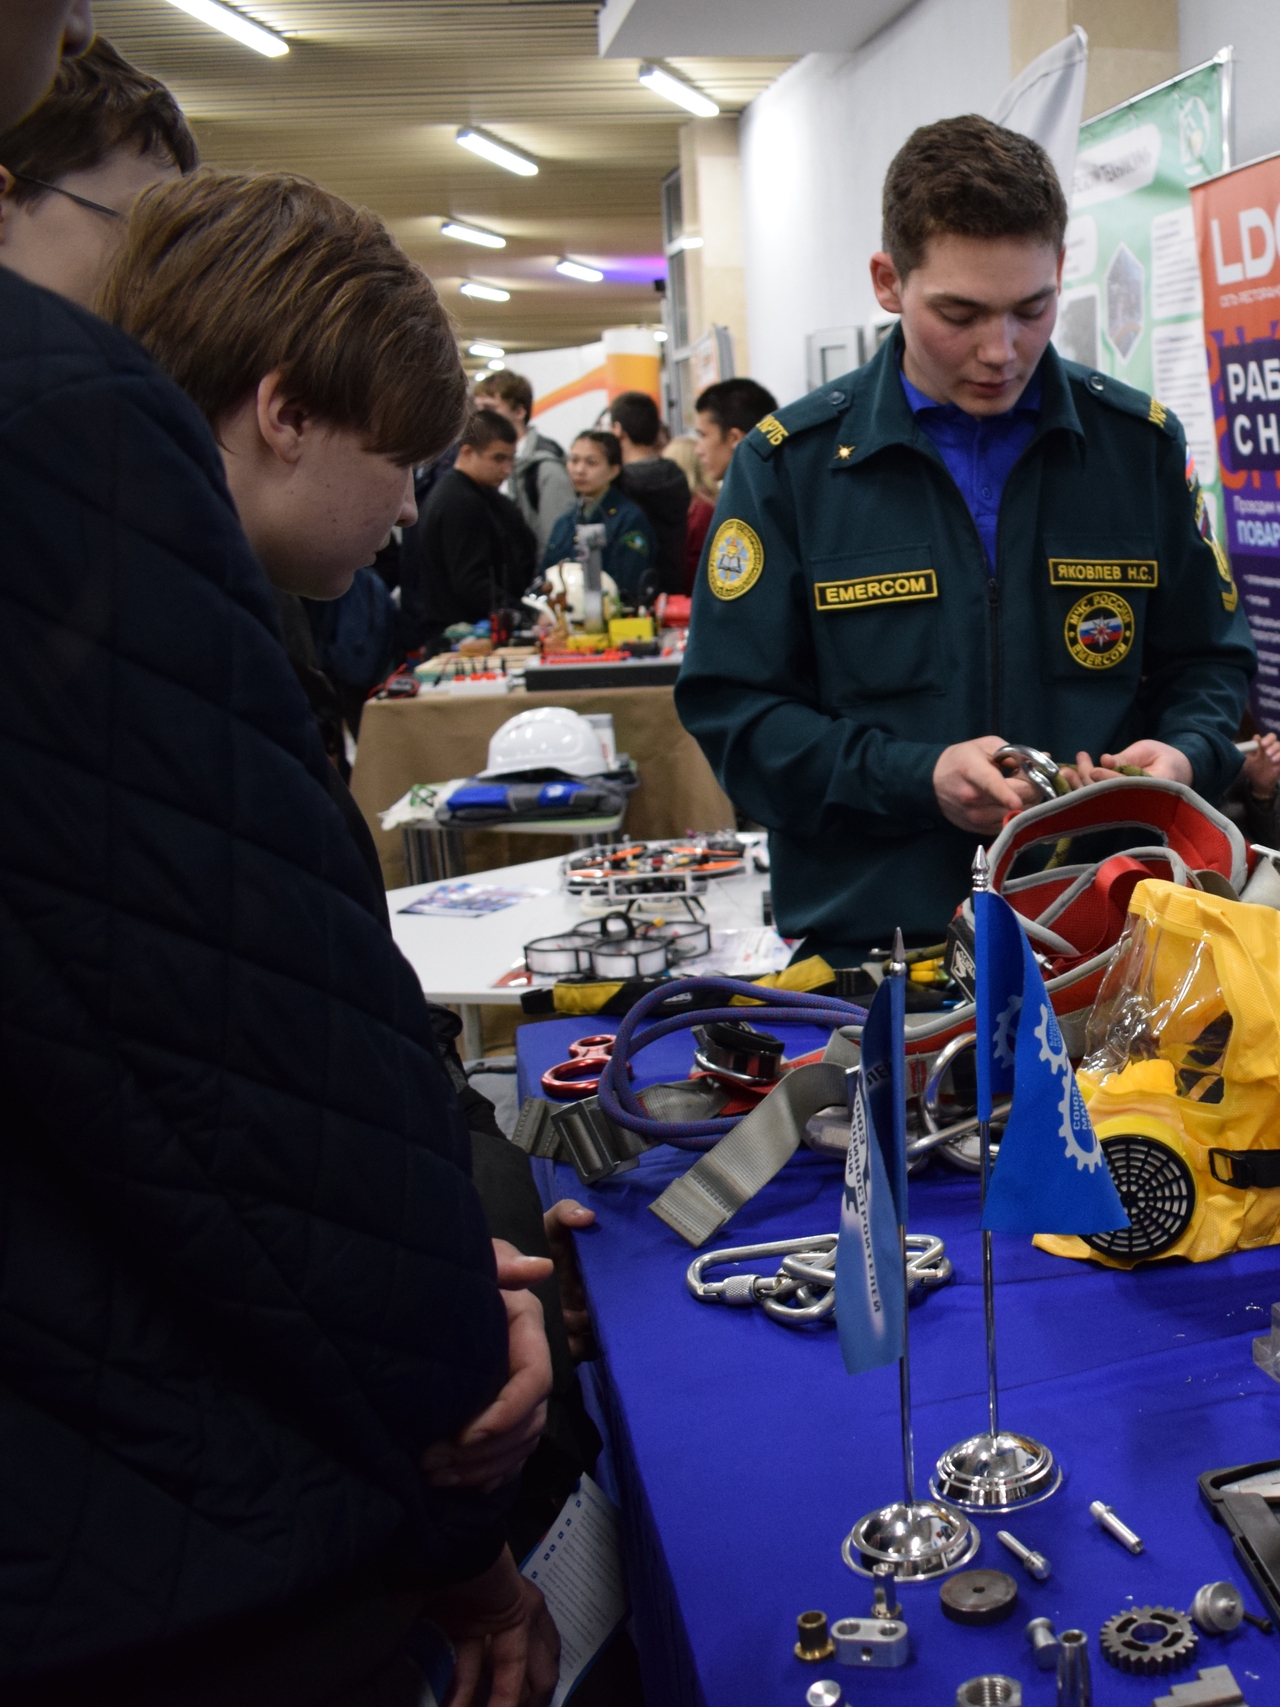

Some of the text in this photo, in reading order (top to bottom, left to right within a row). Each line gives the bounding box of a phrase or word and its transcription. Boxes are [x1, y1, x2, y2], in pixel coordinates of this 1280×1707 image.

[1233, 413, 1254, 457] С
[1057, 564, 1152, 581] ЯКОВЛЕВ Н.С.
[825, 576, 926, 603] EMERCOM
[1069, 594, 1132, 626] МЧС РОССИИ
[1071, 642, 1127, 666] EMERCOM
[1072, 1086, 1081, 1131] СОЮЗ
